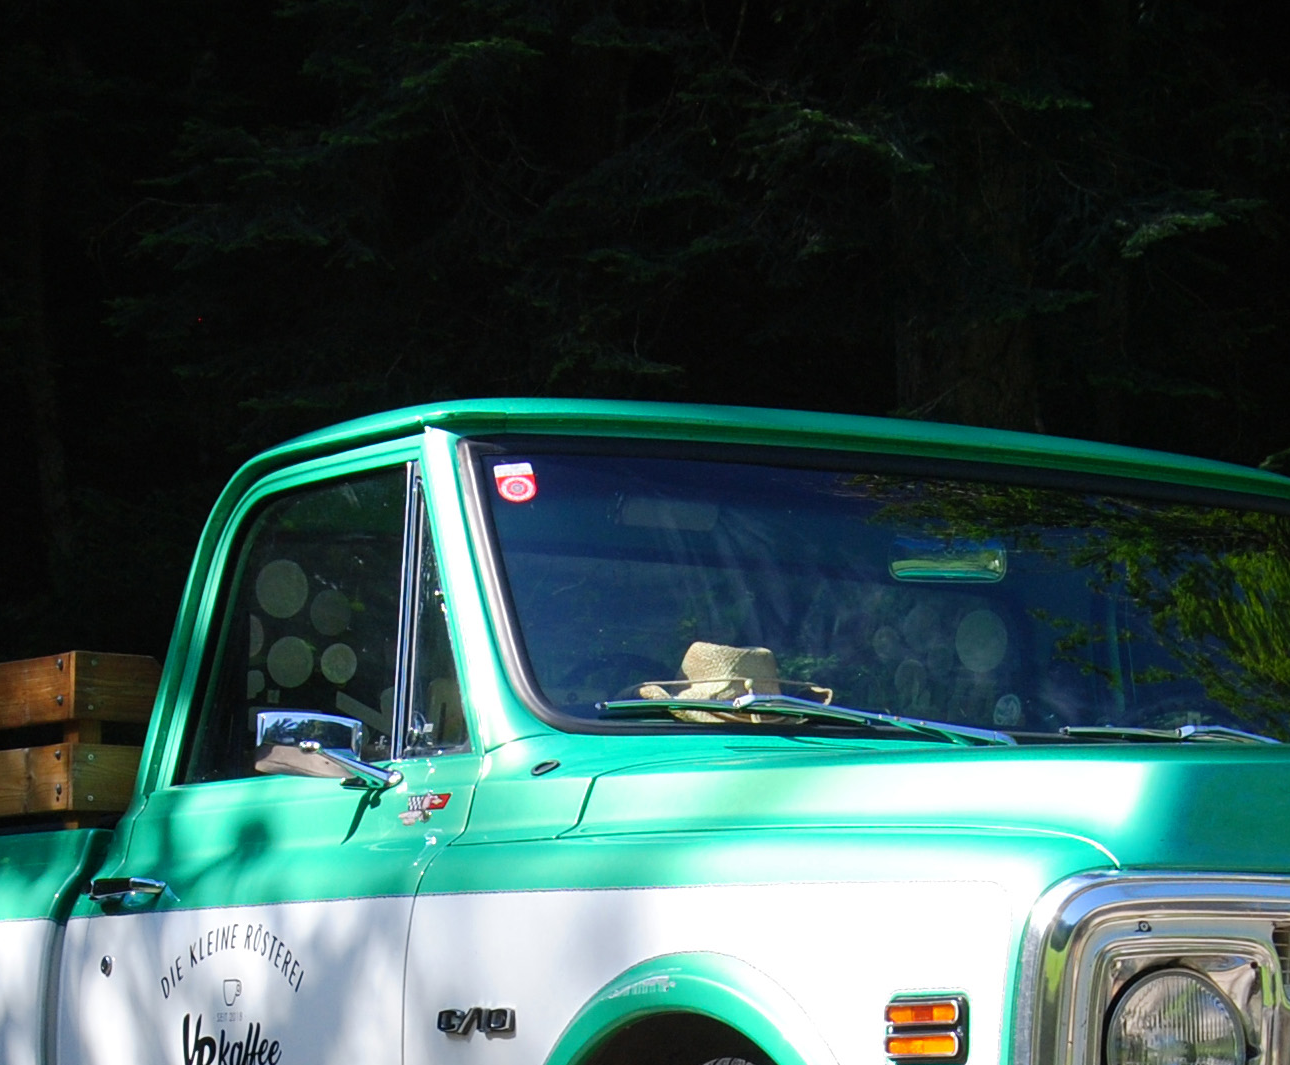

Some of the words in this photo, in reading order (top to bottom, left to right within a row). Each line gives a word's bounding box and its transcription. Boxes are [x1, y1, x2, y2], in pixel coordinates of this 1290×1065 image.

[161, 956, 183, 999] DIE
[190, 924, 239, 968] KLEINE
[244, 924, 304, 993] RÖSTEREI
